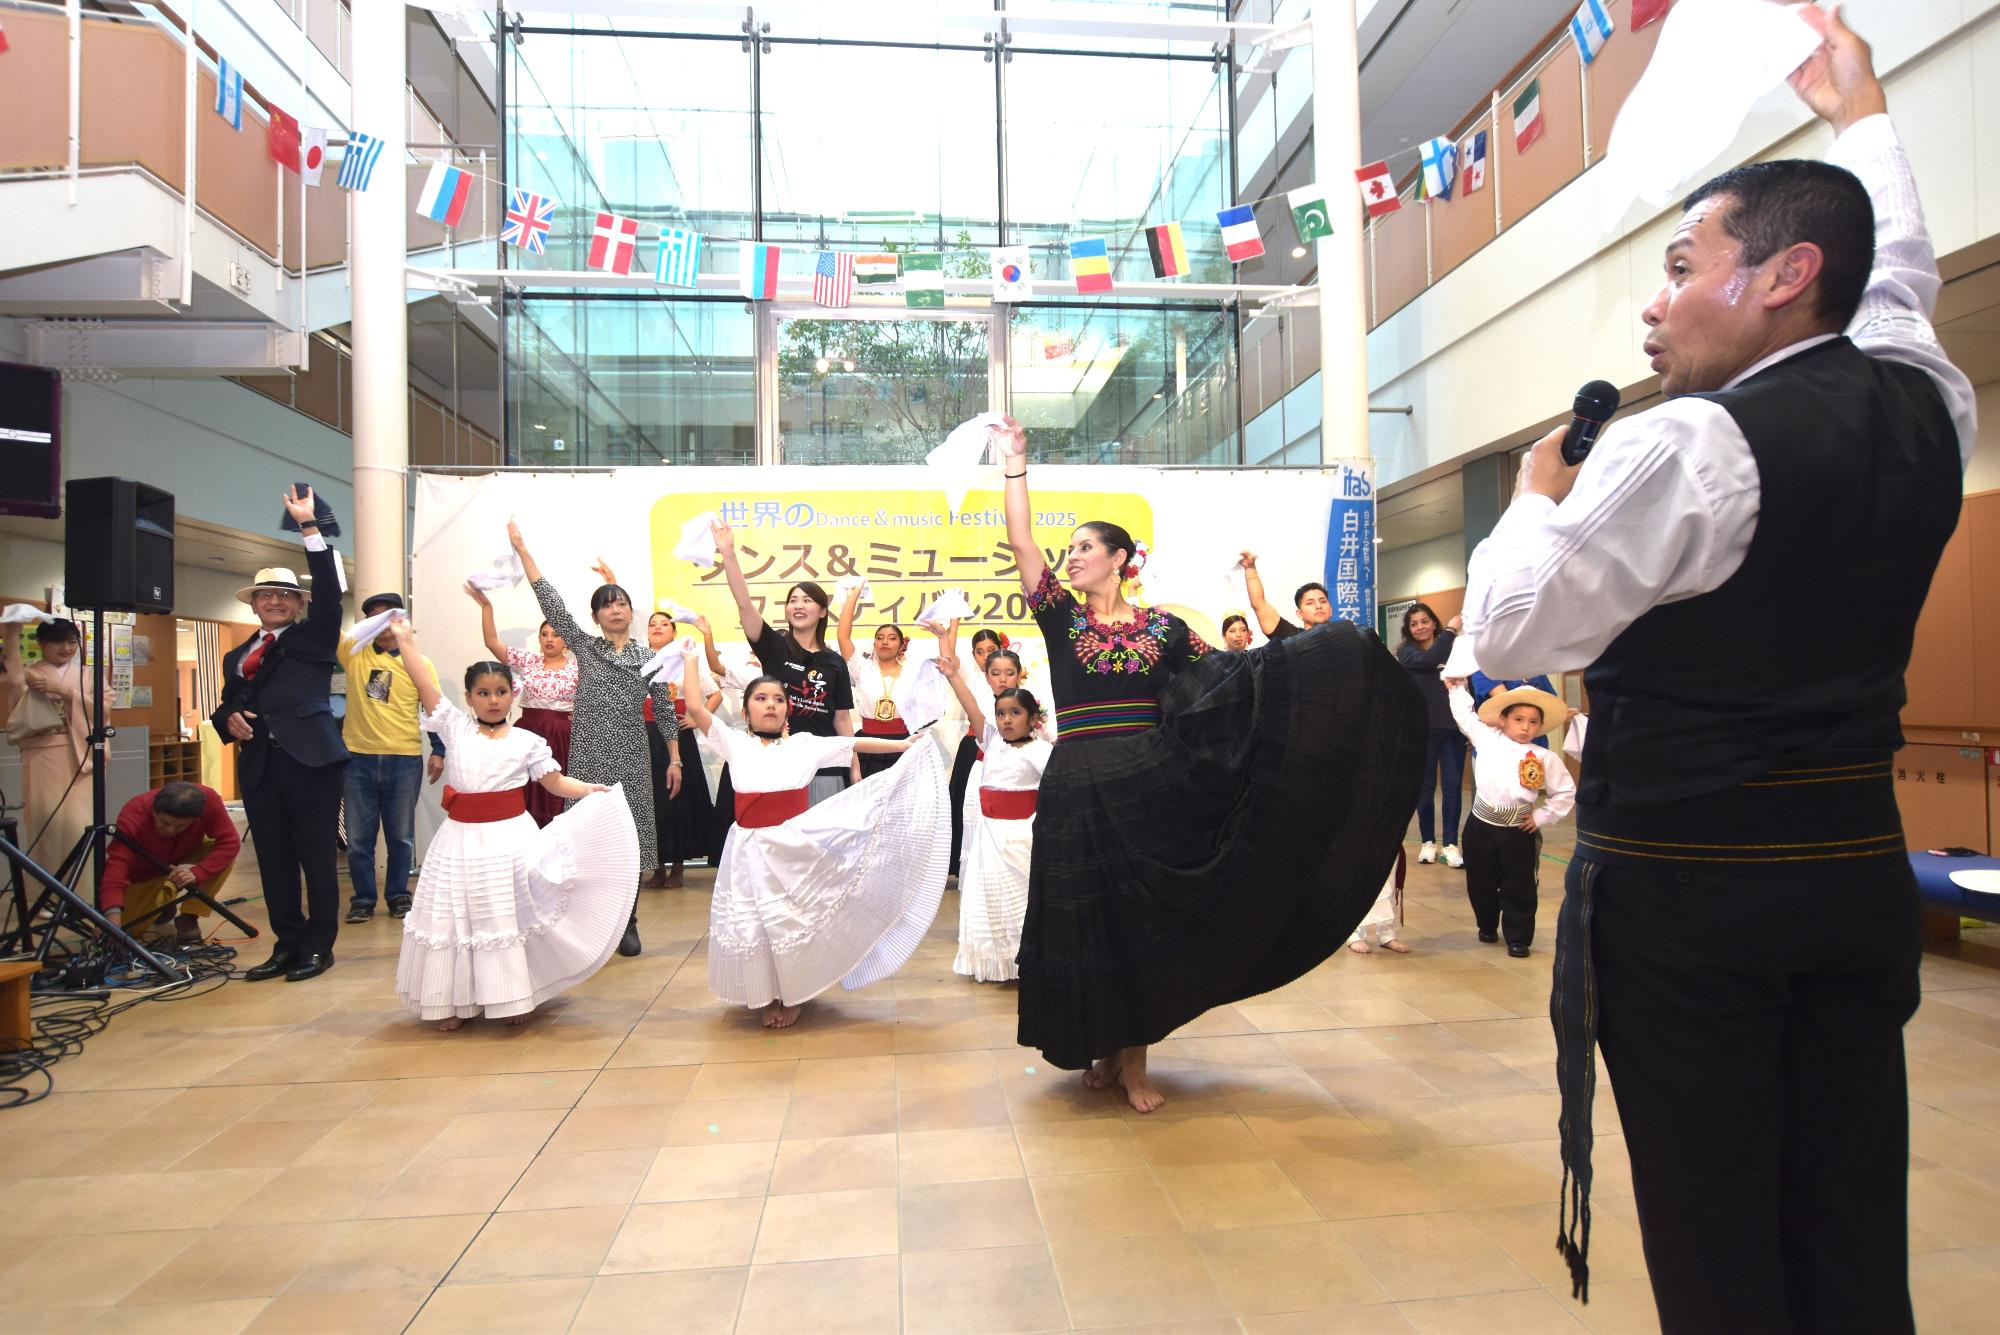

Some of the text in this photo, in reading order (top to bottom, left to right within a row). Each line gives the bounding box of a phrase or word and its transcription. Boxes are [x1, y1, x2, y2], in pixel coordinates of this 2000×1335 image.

[816, 512, 870, 526] Dance
[874, 509, 889, 526] &
[893, 511, 942, 526] music
[950, 508, 1008, 526] Festiv
[1035, 512, 1077, 526] 2025
